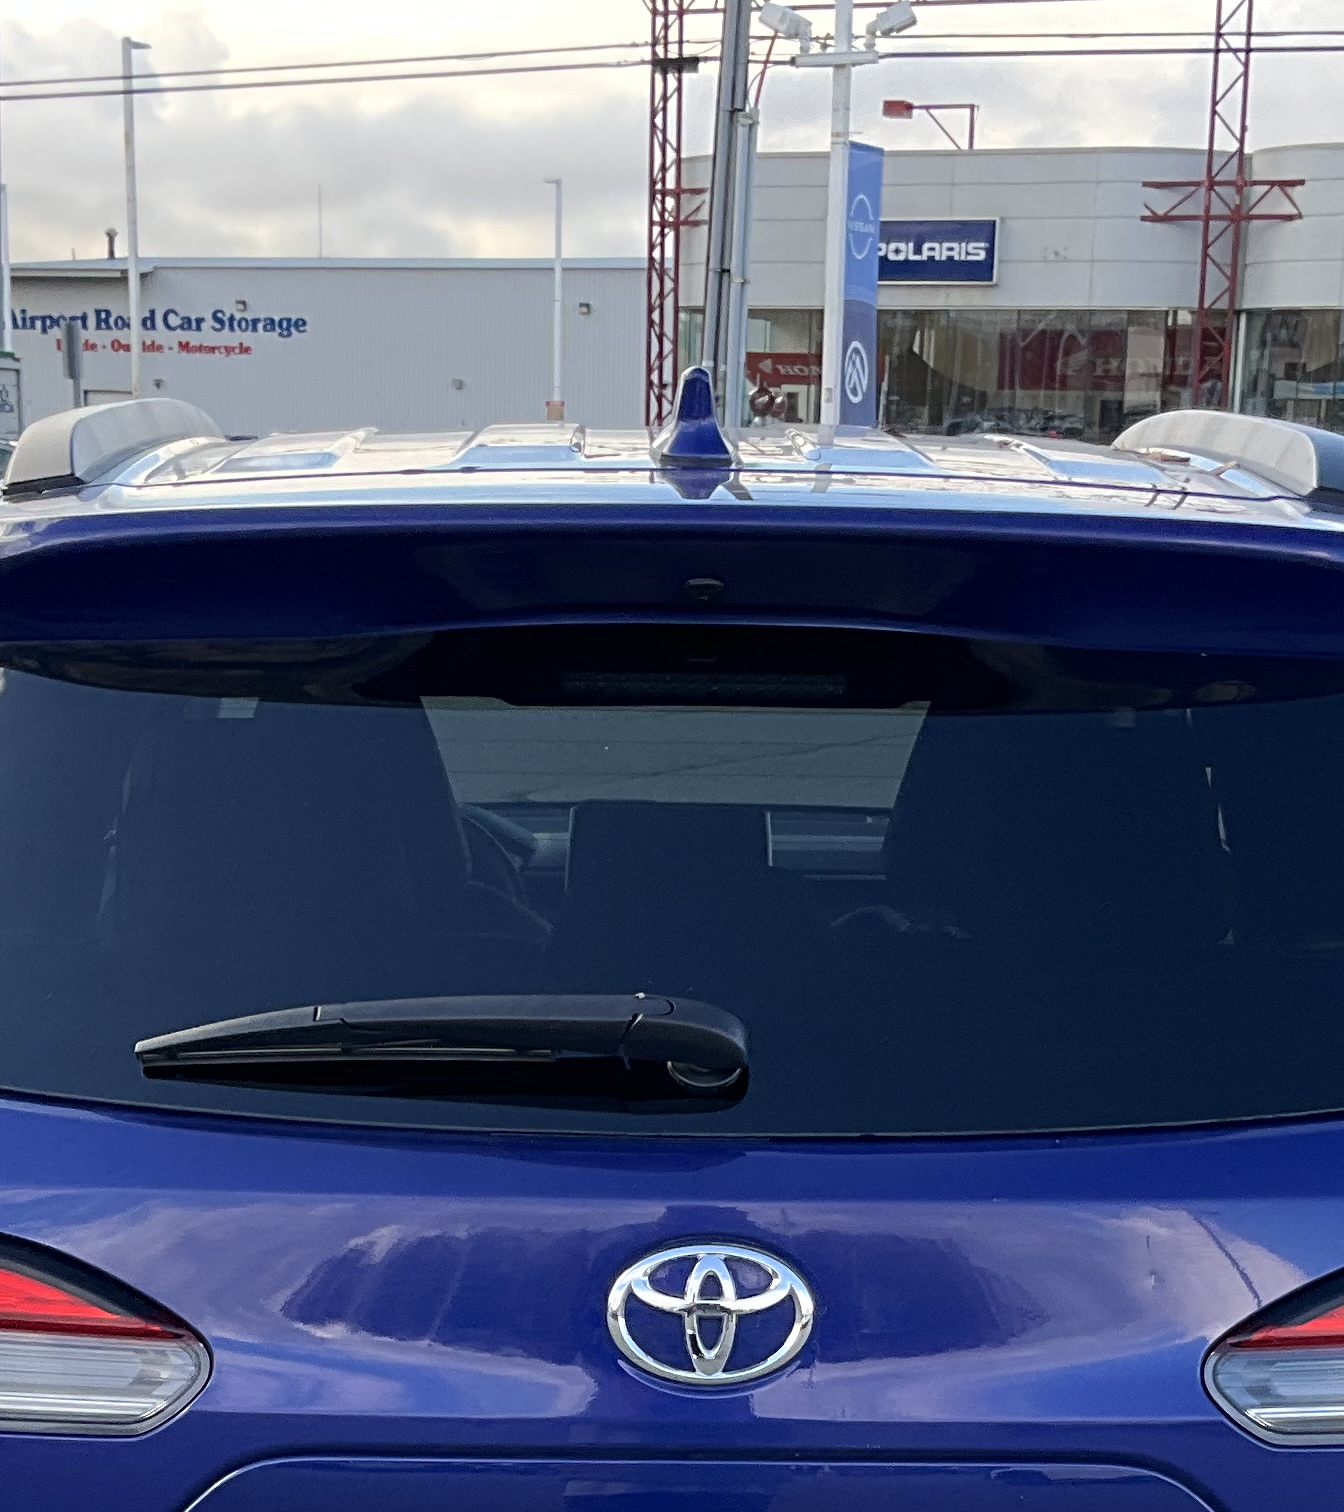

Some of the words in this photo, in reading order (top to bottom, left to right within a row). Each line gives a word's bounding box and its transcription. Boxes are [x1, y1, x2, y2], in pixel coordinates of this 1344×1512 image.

[162, 308, 206, 332] Car
[211, 309, 308, 339] Storage
[177, 340, 254, 357] Motorcycle
[776, 364, 823, 376] HON
